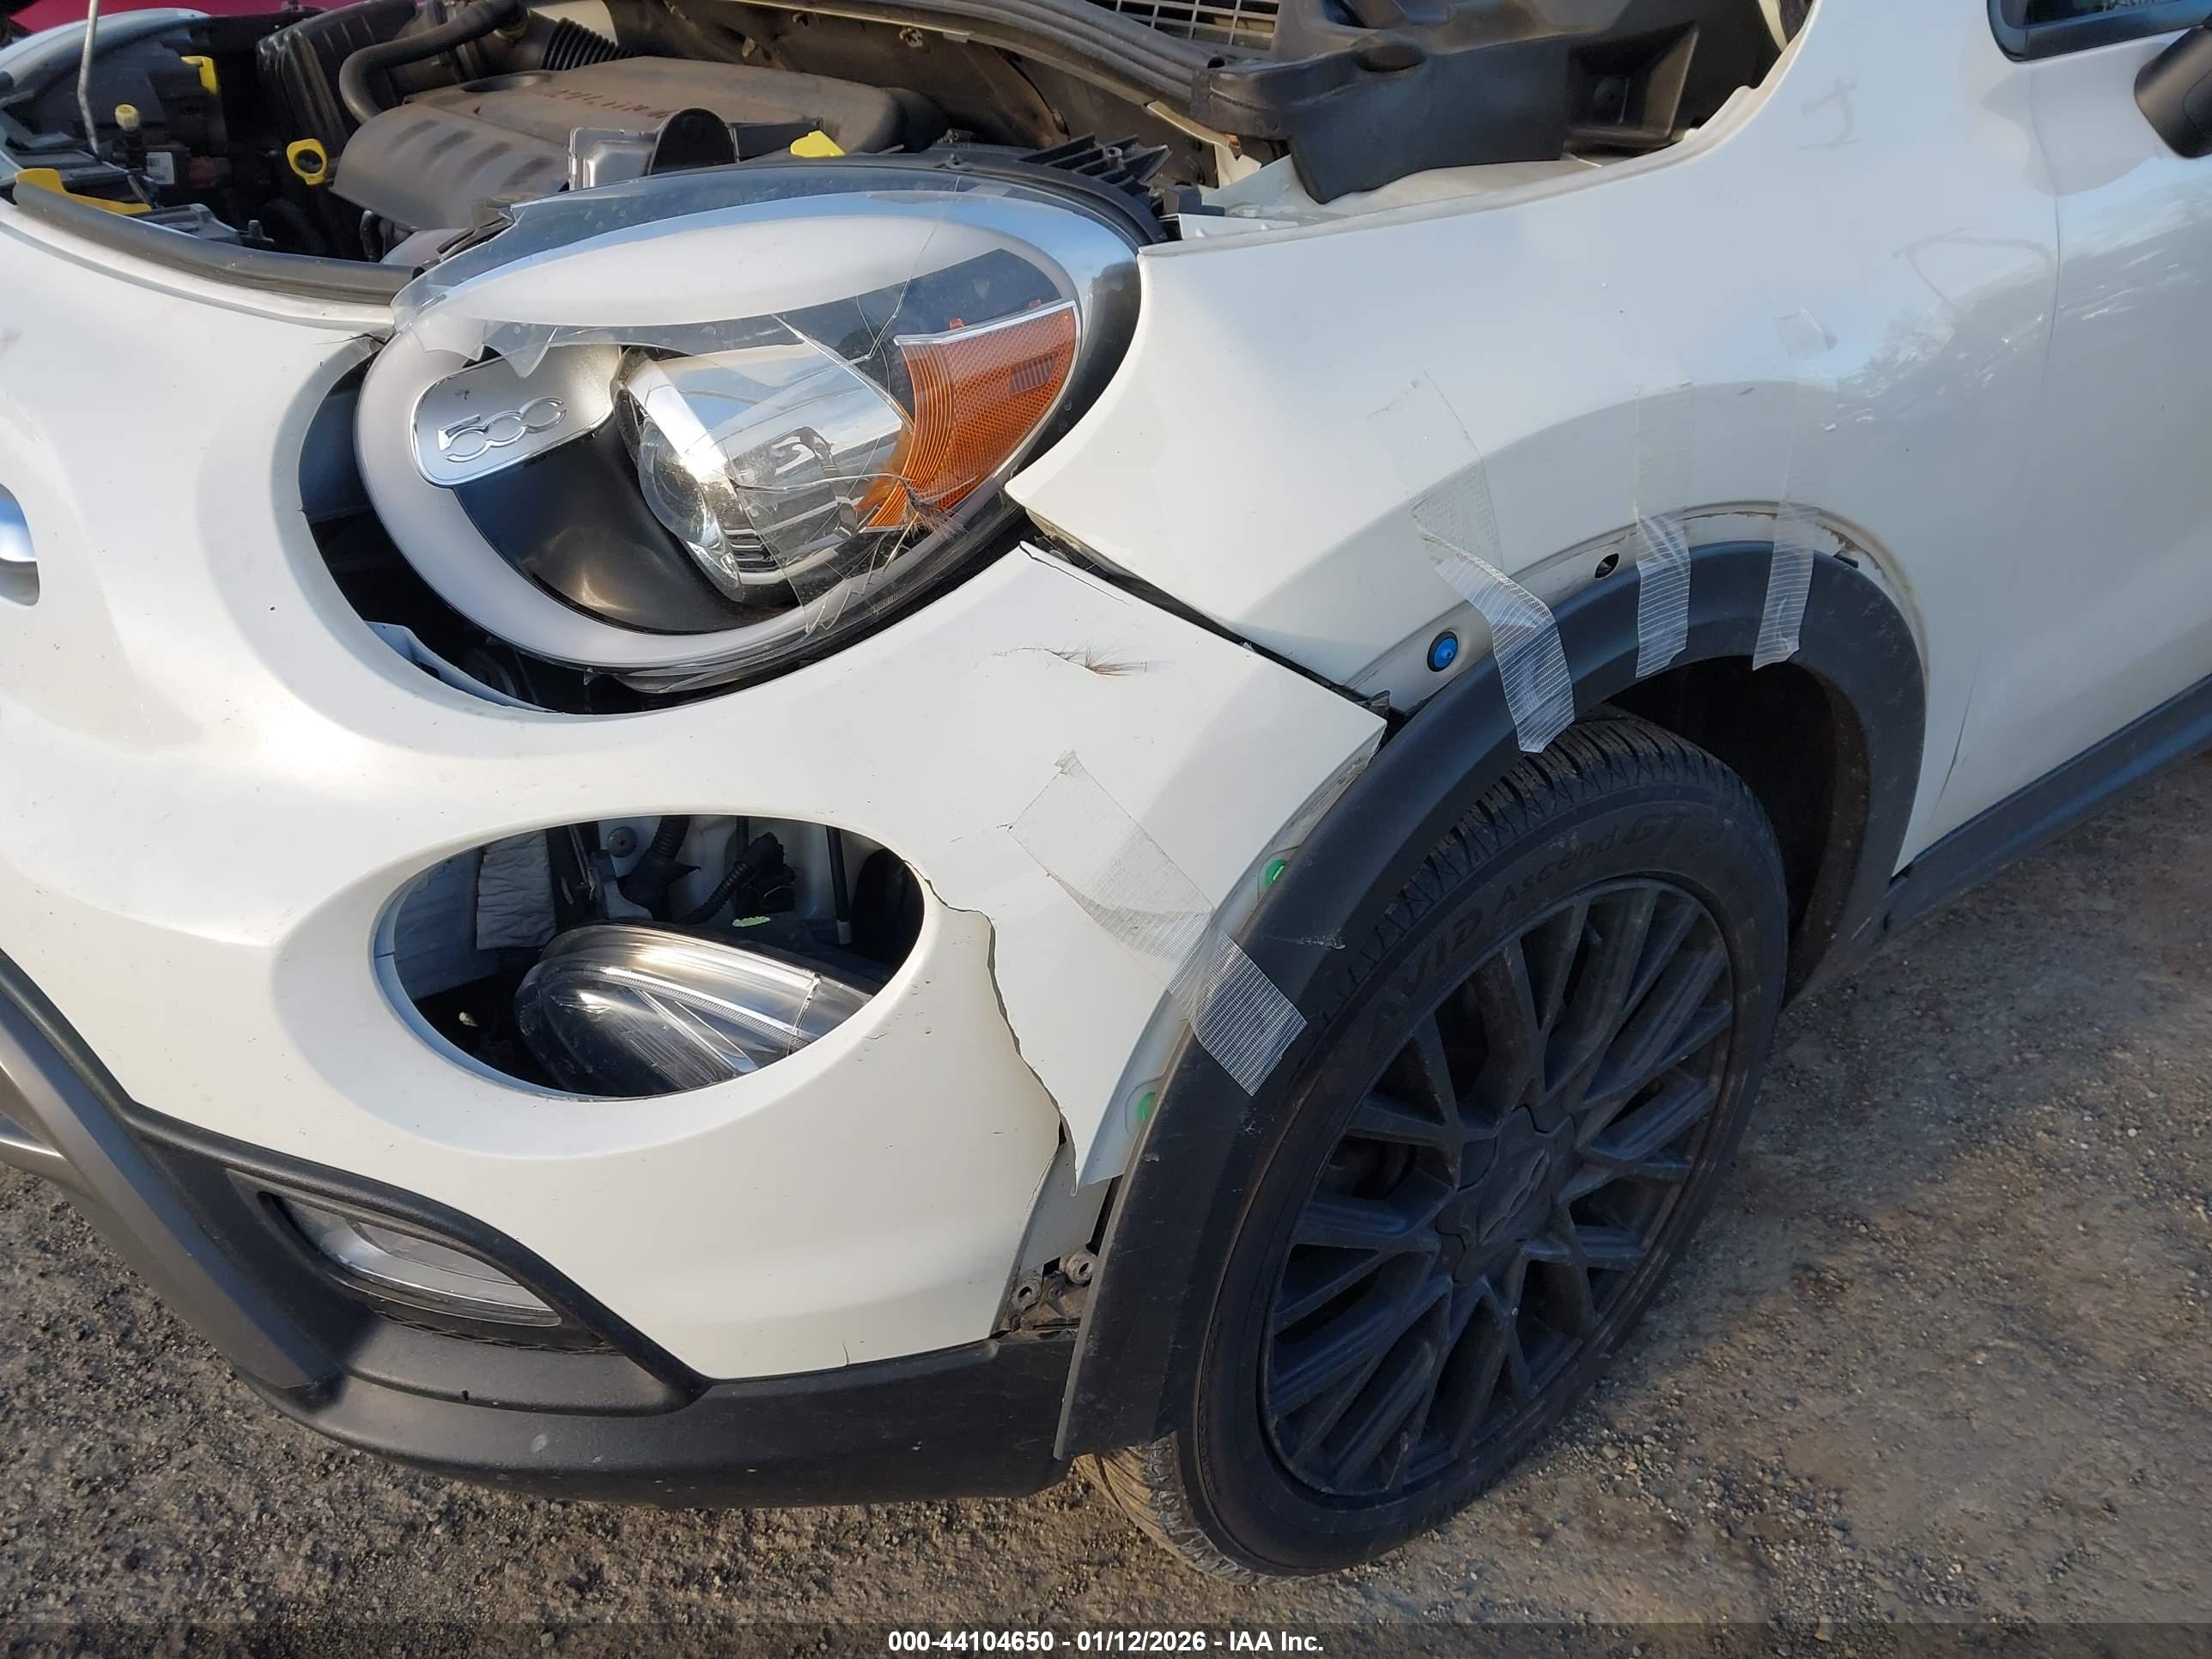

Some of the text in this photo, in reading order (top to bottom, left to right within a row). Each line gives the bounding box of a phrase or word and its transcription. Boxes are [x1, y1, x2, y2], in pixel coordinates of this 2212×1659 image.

[437, 397, 568, 463] 500
[1494, 823, 1620, 915] Ascend
[1621, 811, 1692, 845] GT
